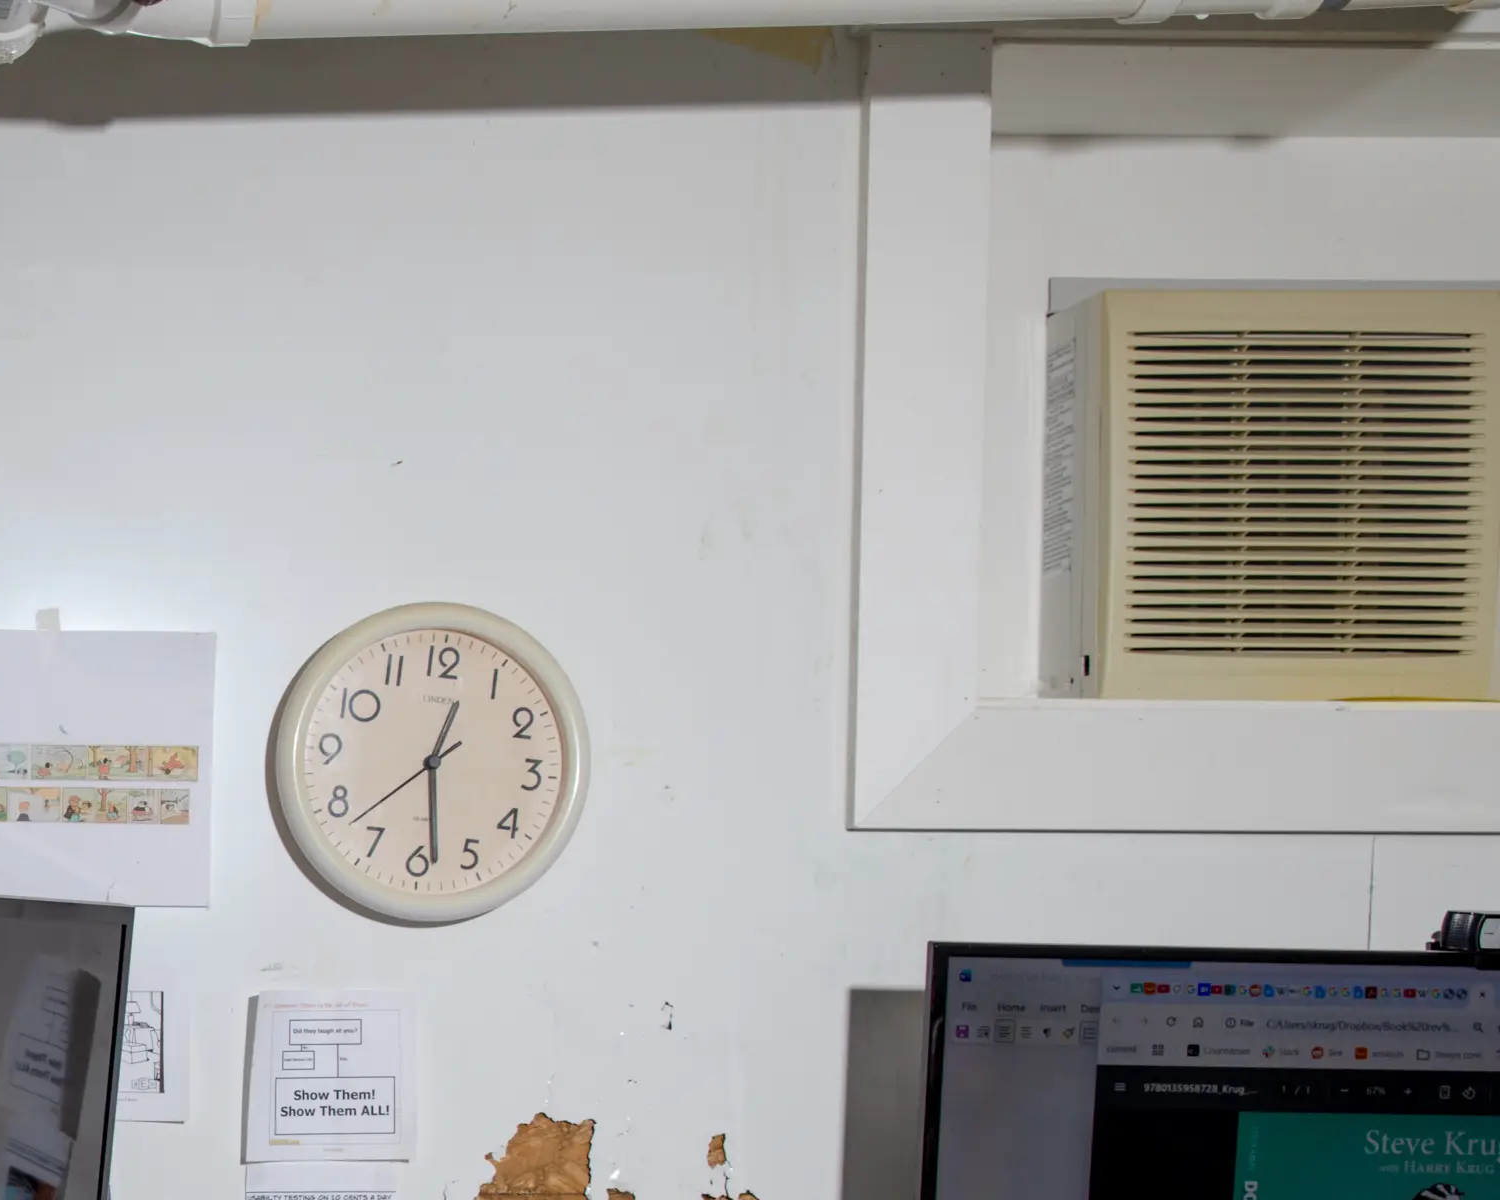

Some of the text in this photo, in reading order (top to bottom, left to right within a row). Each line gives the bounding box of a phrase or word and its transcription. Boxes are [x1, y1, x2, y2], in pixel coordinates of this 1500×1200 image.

[384, 653, 404, 687] 11
[426, 645, 460, 680] 12
[490, 668, 498, 700] 1
[340, 687, 381, 722] 10
[512, 707, 534, 740] 2
[319, 733, 343, 765] 9
[520, 758, 543, 791] 3
[328, 785, 349, 818] 8
[497, 808, 519, 839] 4
[366, 826, 386, 858] 7
[460, 838, 480, 870] 5
[405, 845, 430, 877] 6
[961, 1002, 1067, 1013] File Home Insert
[280, 1105, 390, 1117] Show Them ALL!
[293, 1089, 376, 1101] Show Them!
[1363, 1130, 1500, 1162] Steve Kru
[1404, 1160, 1495, 1174] HARRY KRUG
